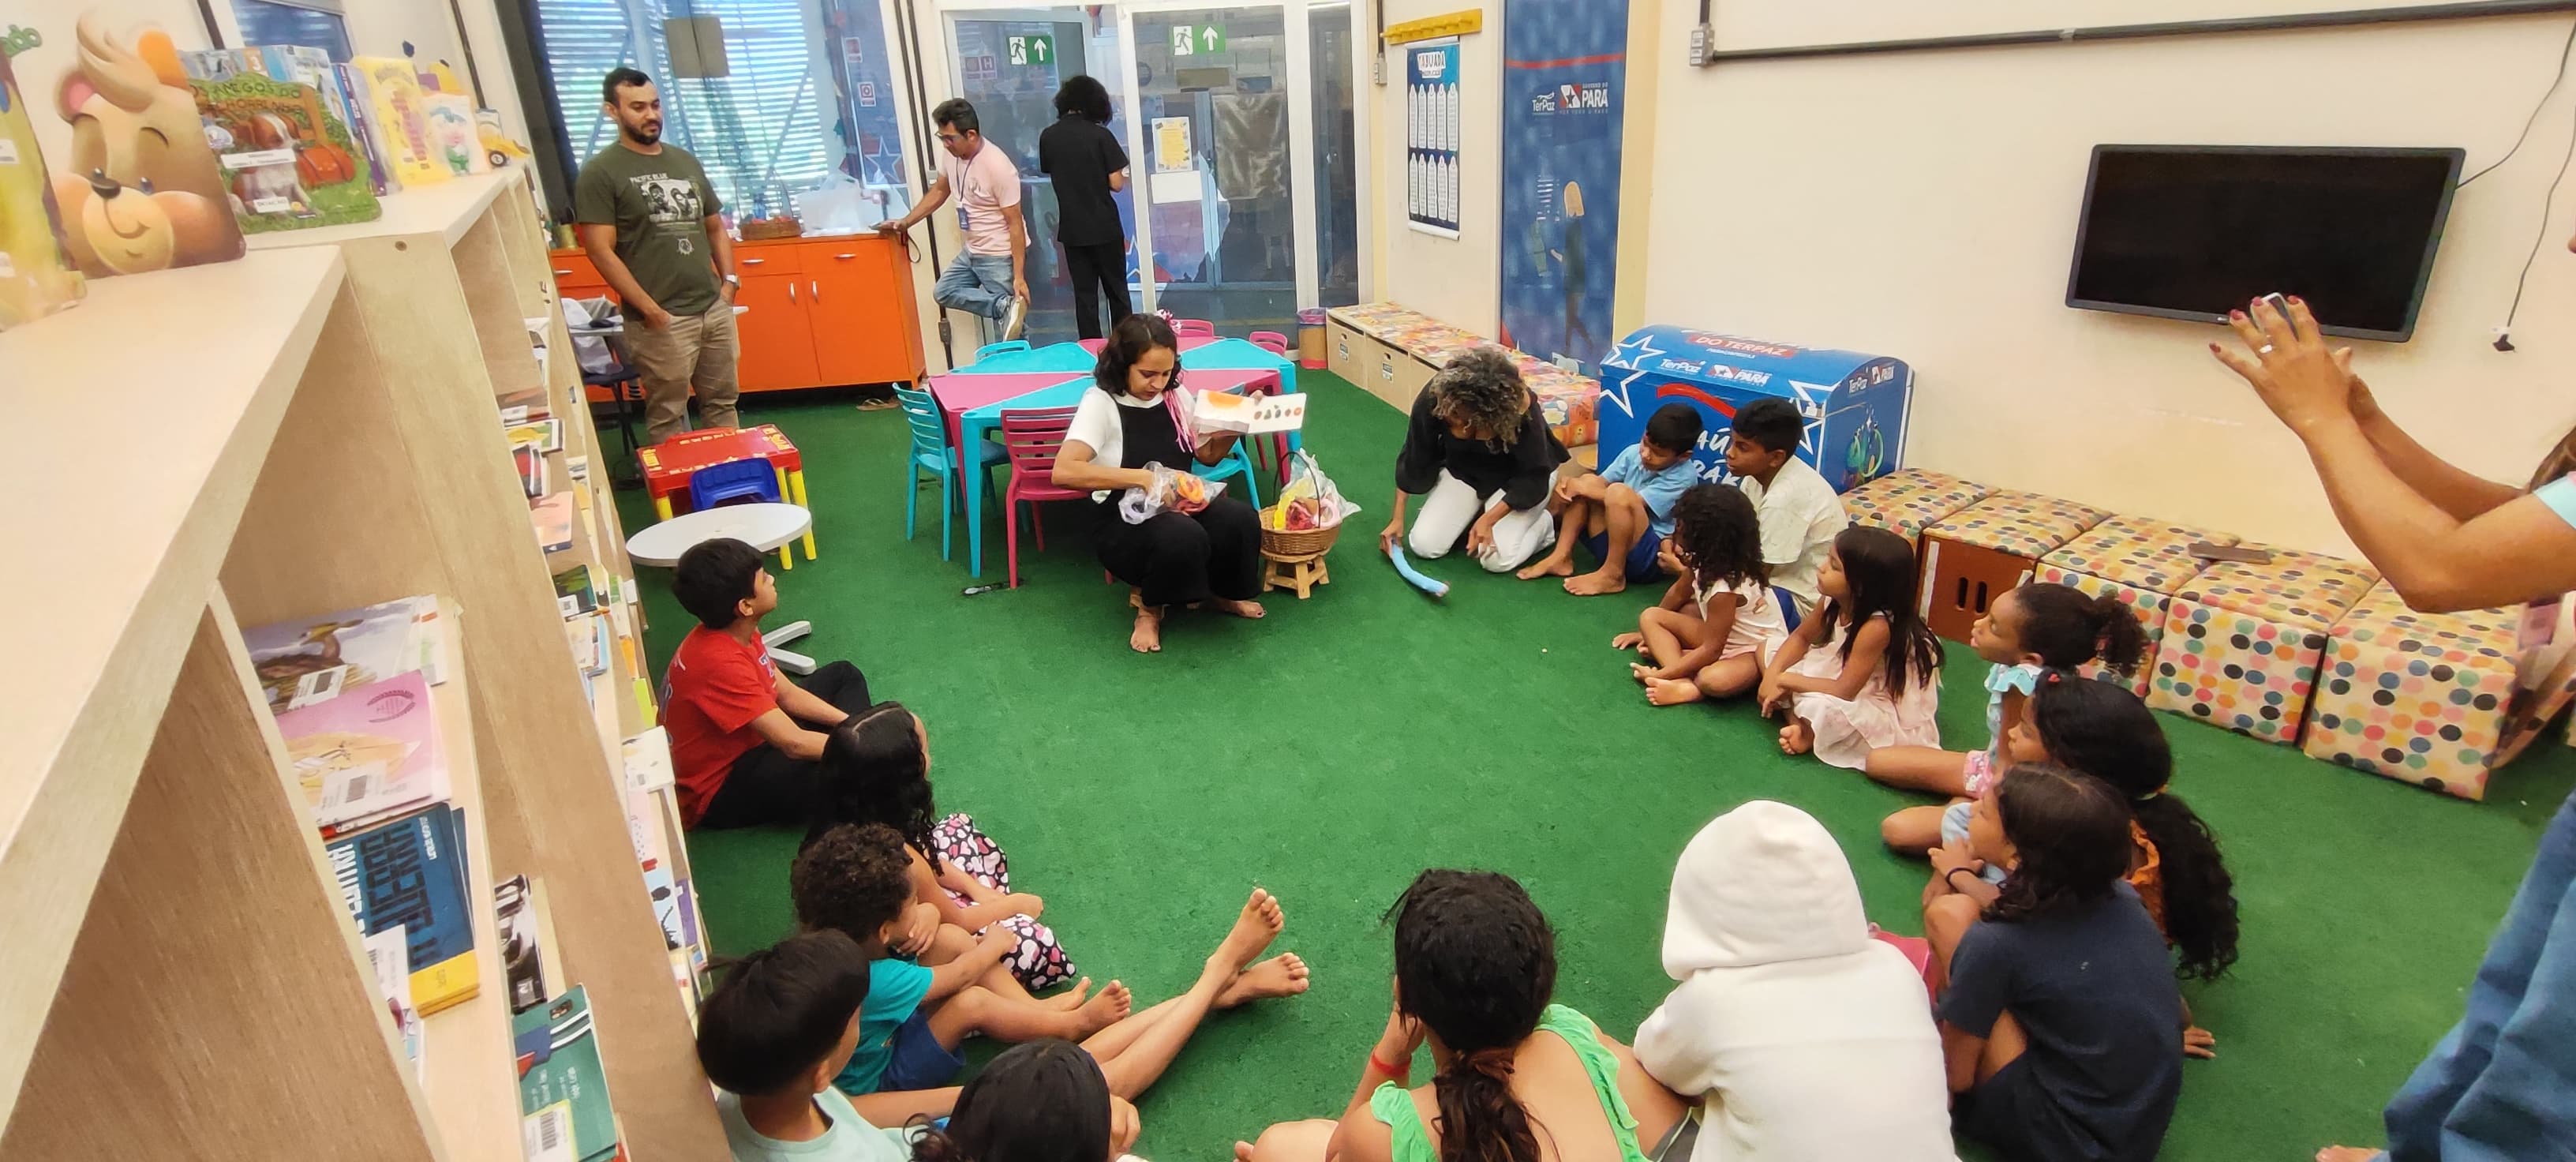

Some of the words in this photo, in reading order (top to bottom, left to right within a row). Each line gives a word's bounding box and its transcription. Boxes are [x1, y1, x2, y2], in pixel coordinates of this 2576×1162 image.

[1531, 99, 1556, 112] TerPaz
[1696, 336, 1723, 346] DO
[1724, 340, 1788, 356] TERPAZ
[1660, 358, 1702, 373] TerPaz
